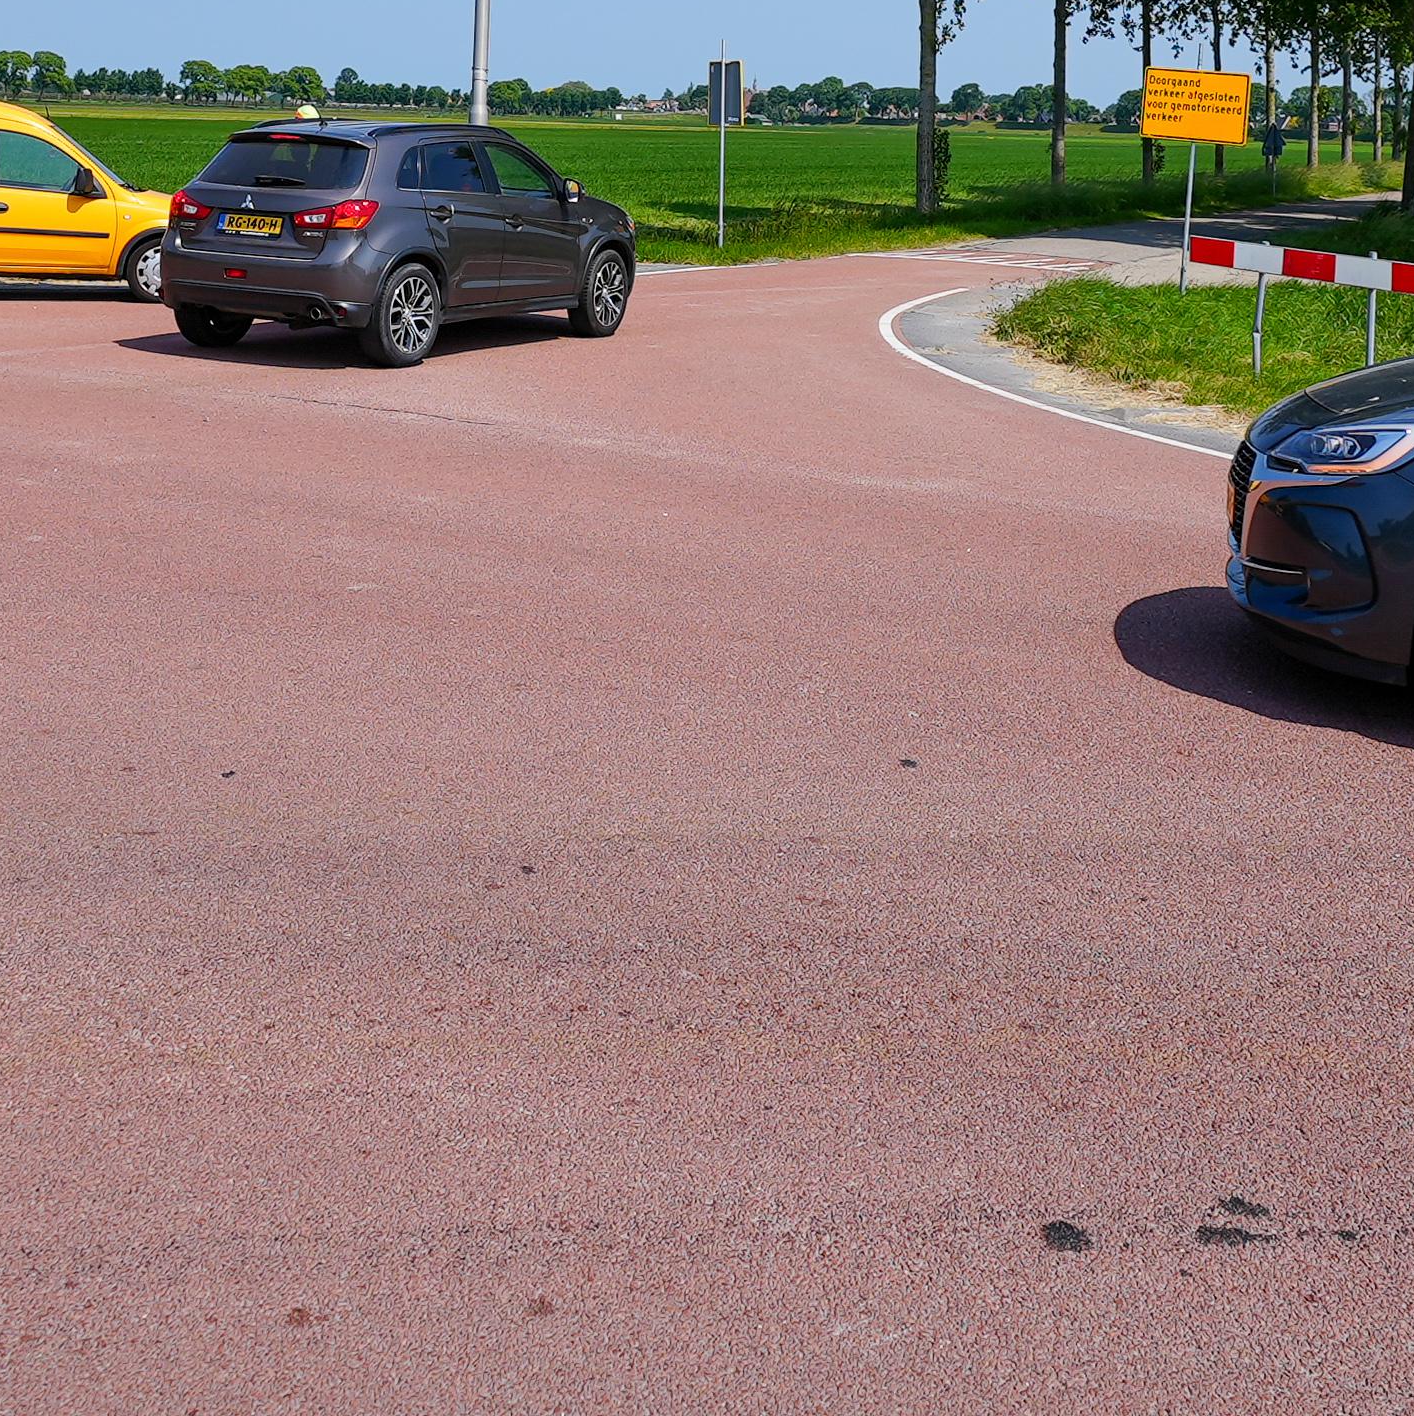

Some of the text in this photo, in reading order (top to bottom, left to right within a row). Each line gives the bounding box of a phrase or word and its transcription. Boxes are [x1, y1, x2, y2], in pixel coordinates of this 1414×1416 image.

[1149, 74, 1201, 88] Doorgaand
[1148, 88, 1240, 103] verkeer afgesloten
[1147, 100, 1242, 115] voor gemotoriseerd
[1146, 112, 1183, 122] verkeer
[227, 216, 278, 231] RG-140-H
